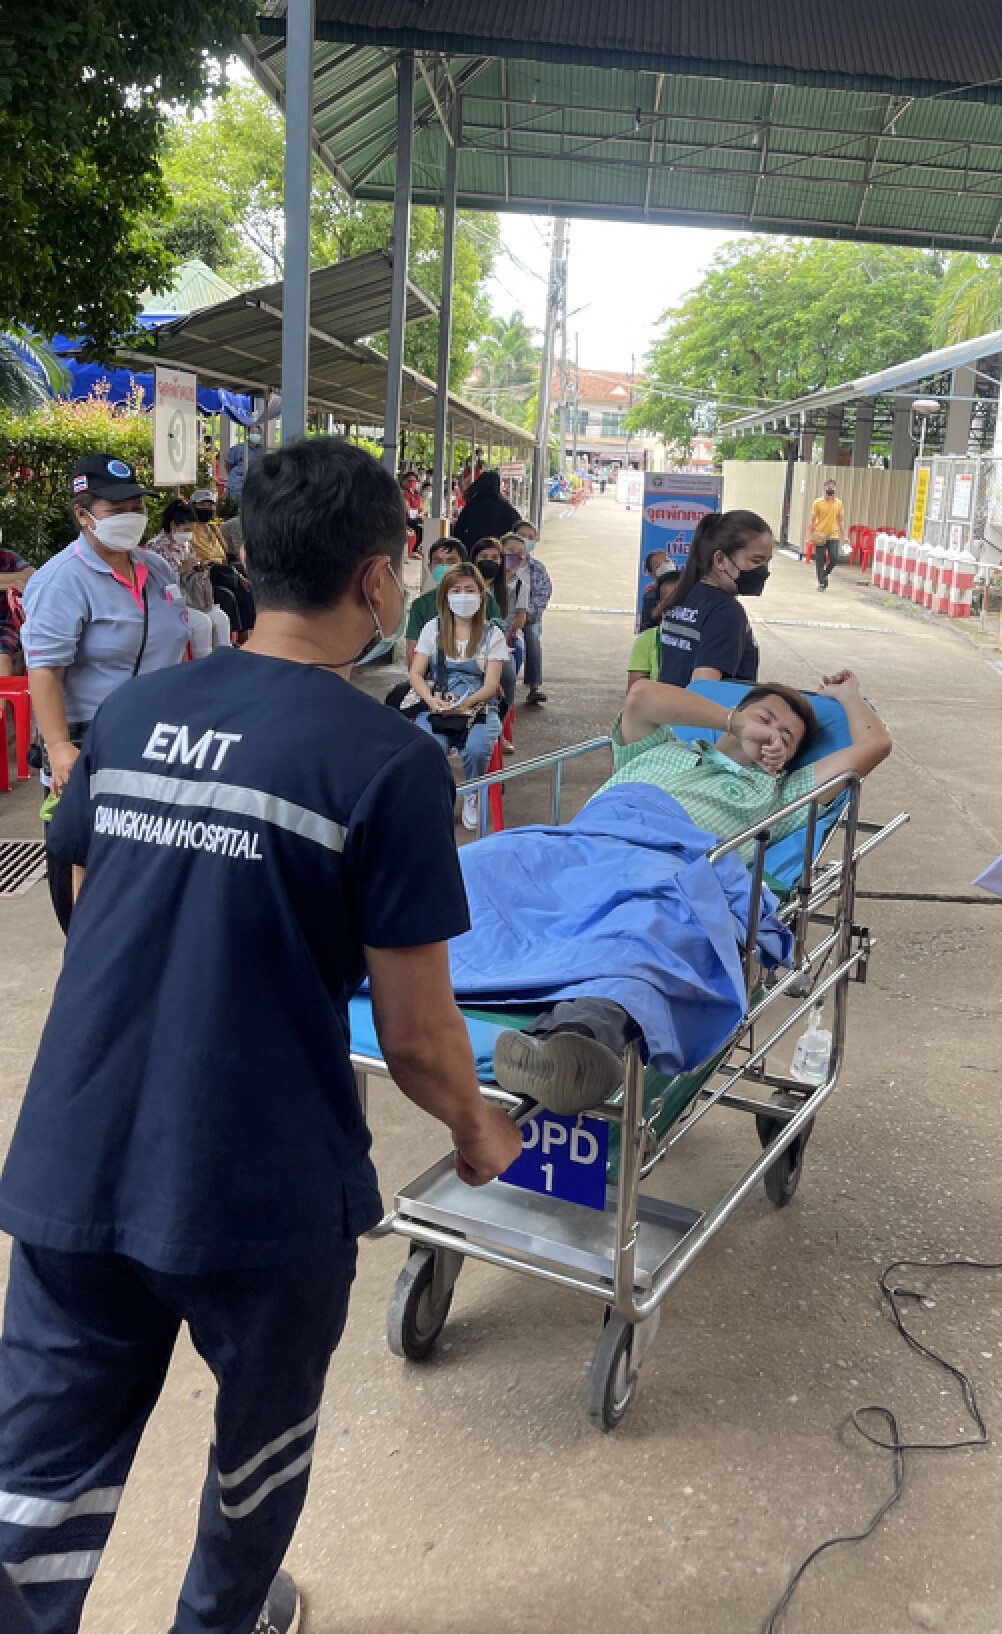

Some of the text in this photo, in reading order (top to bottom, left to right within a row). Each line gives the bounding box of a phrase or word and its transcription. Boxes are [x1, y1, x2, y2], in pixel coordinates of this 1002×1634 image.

[647, 504, 706, 523] จุดพักคอ
[141, 721, 243, 771] EMT
[174, 818, 263, 860] HOSPITAL
[541, 1162, 554, 1192] 1
